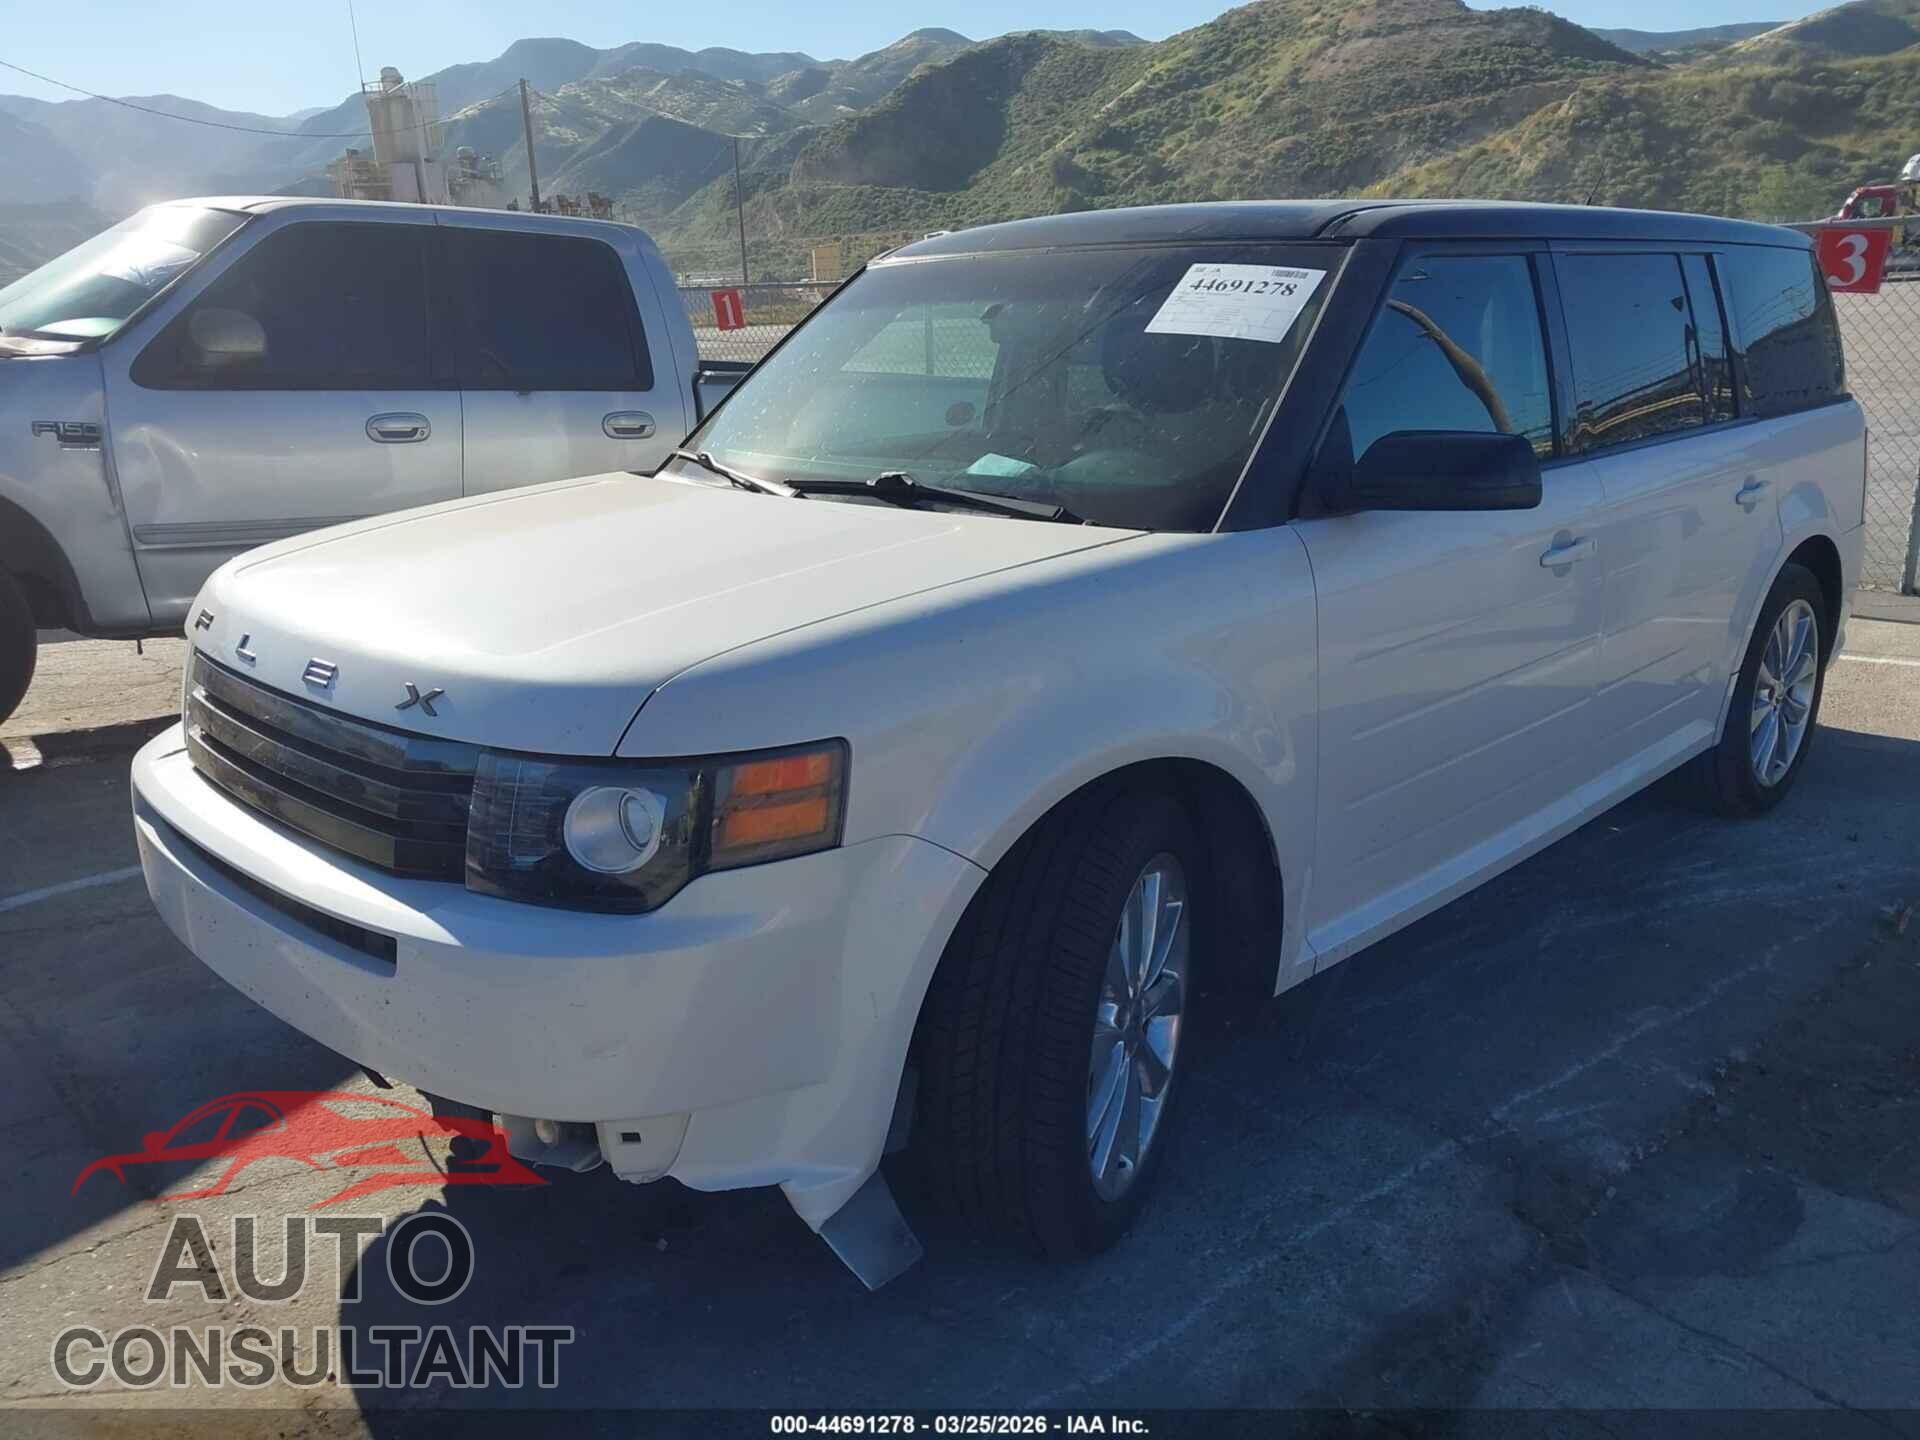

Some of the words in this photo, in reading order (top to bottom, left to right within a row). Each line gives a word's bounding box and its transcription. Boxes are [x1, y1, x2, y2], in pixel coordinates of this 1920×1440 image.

[1826, 234, 1868, 287] 3
[1190, 278, 1299, 297] 44691278
[722, 294, 736, 327] 1
[195, 607, 445, 717] FLEX
